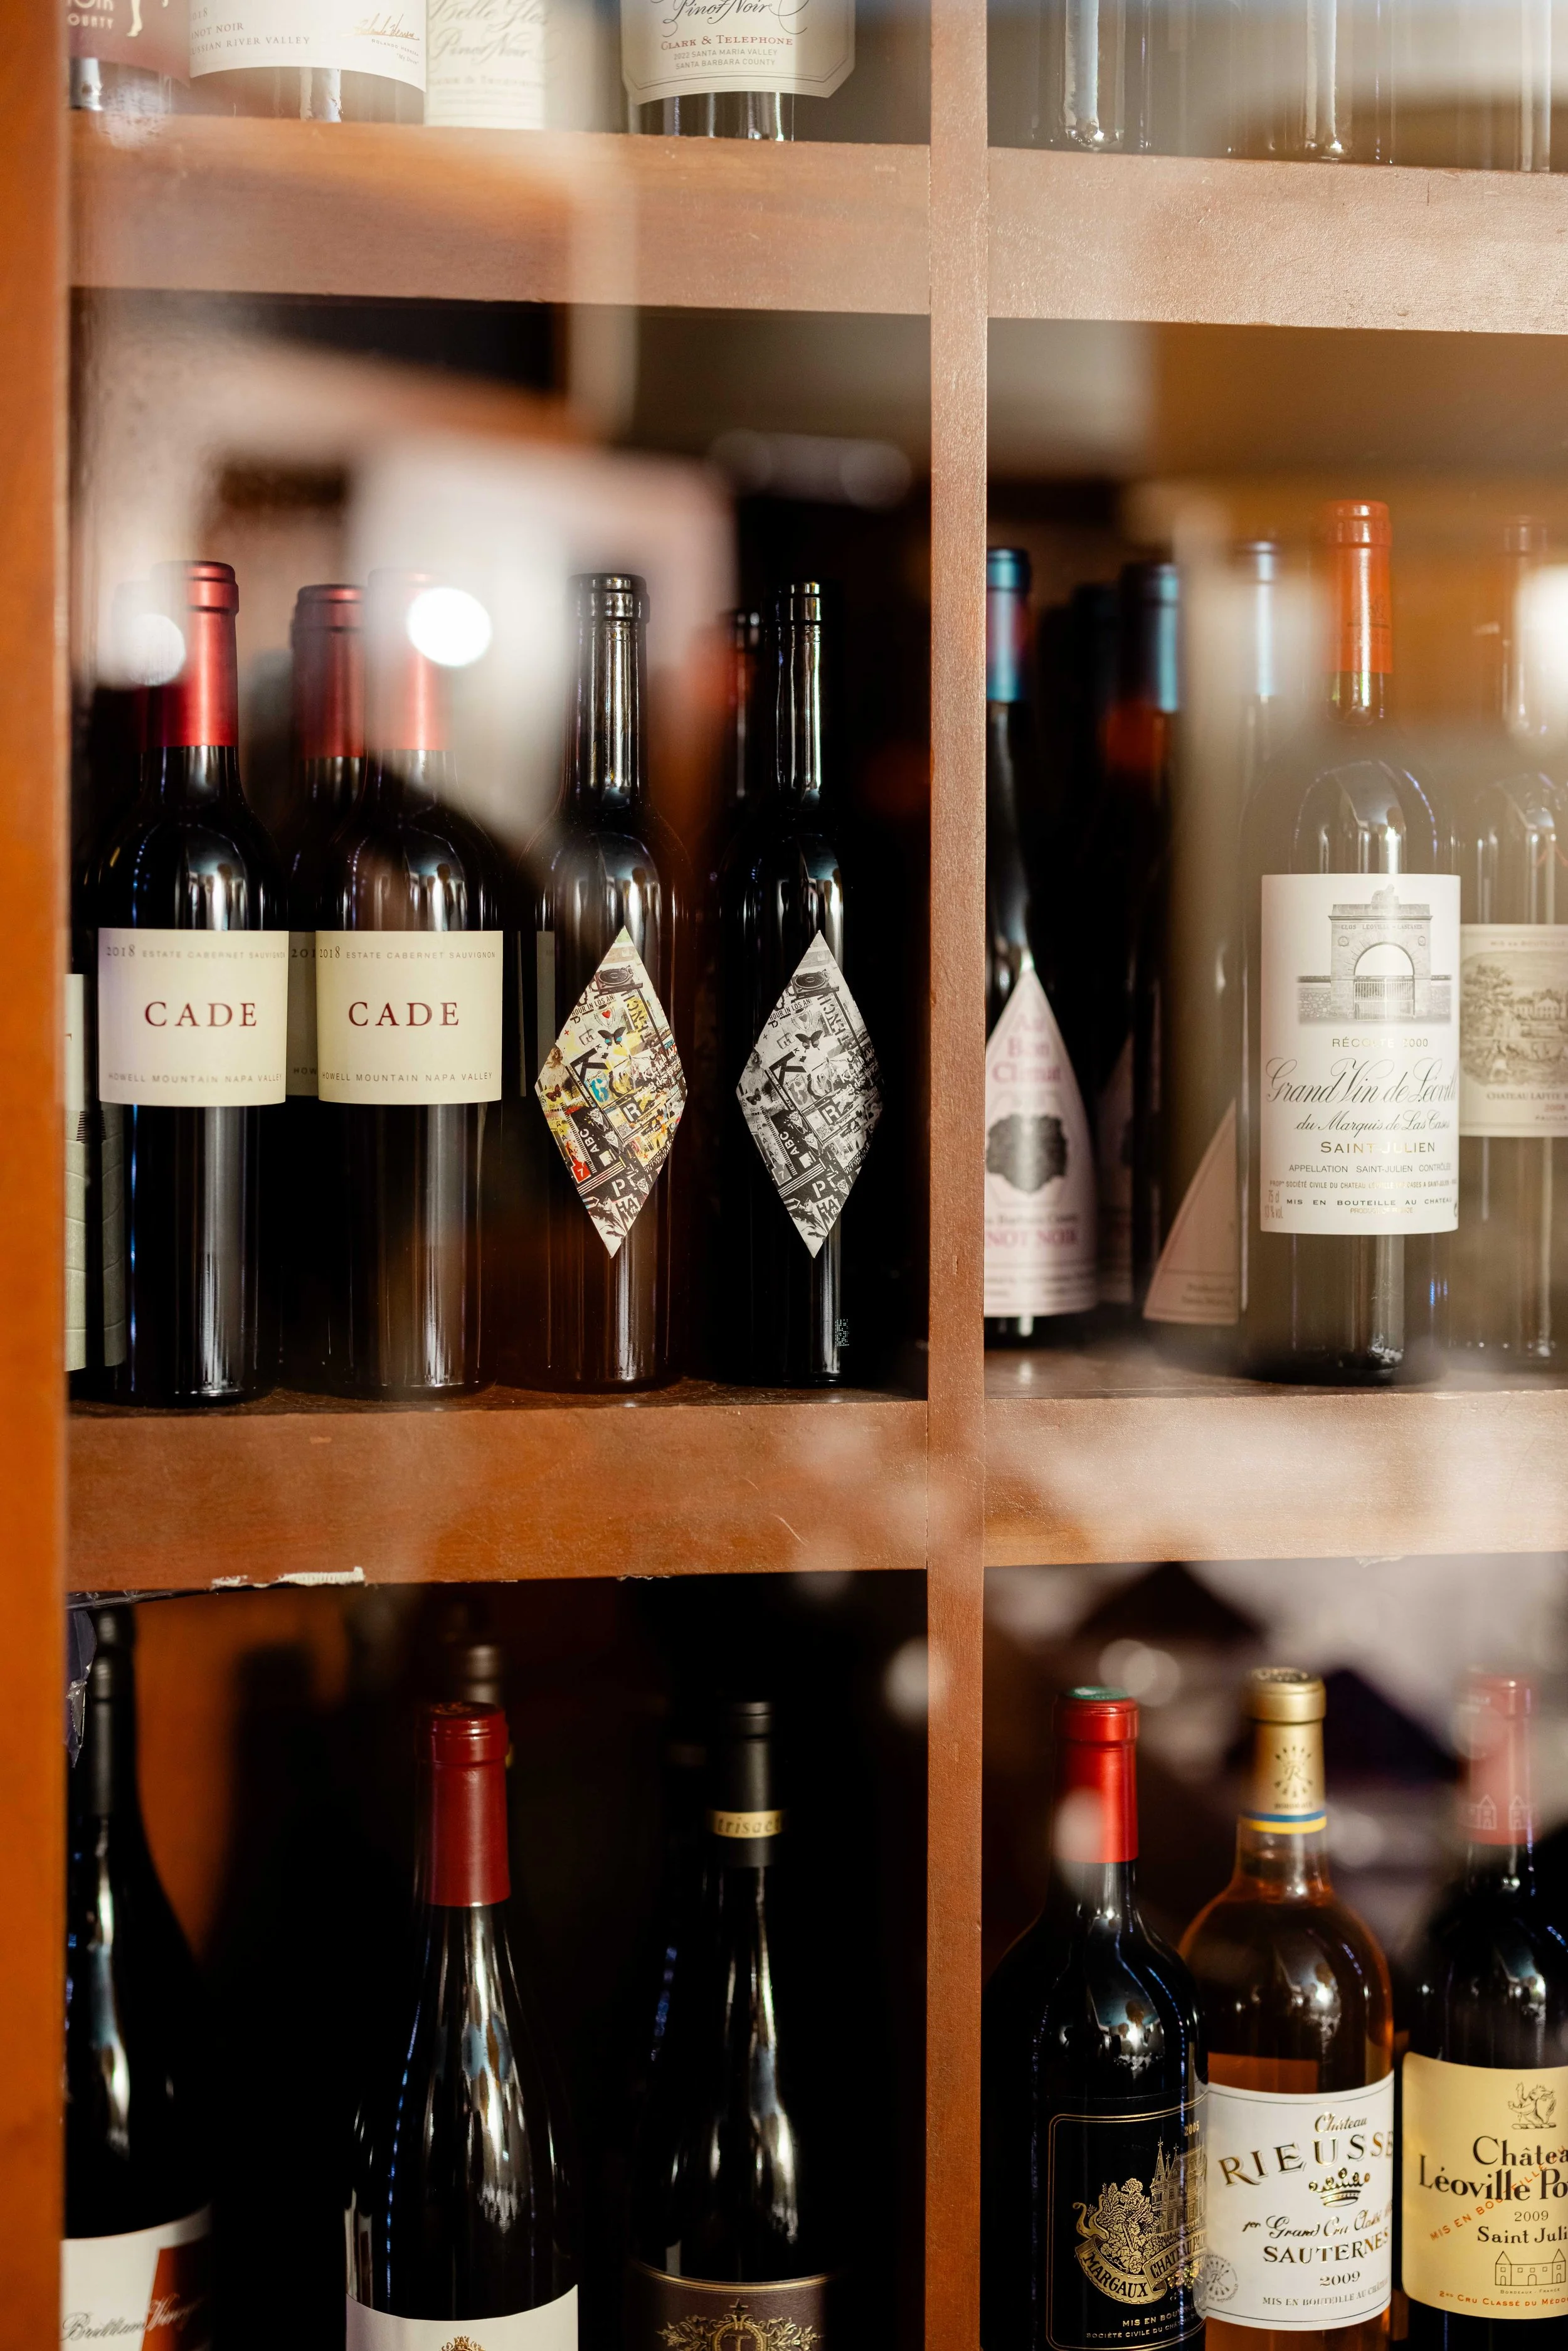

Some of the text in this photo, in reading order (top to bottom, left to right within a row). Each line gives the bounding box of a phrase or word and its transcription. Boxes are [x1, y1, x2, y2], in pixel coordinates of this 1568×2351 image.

[189, 7, 208, 21] 018
[216, 22, 244, 34] NOIR
[189, 36, 310, 56] USSIAN RIVER VALLEY
[371, 38, 399, 50] ROLANDO
[701, 35, 712, 45] &
[674, 48, 778, 61] 2022 SANTA MARIA VALLEY
[675, 58, 776, 70] SANTA BARBARA COUNTY
[106, 943, 136, 958] 2018
[142, 950, 182, 958] ESTATE
[187, 950, 245, 960] CABERNET
[319, 945, 341, 959] 2018
[386, 952, 445, 960] CABERNET
[448, 951, 496, 959] SAUVIGNON
[144, 1000, 258, 1027] CADE
[348, 1000, 460, 1027] CADE
[571, 1005, 587, 1017] HOUR
[586, 1002, 594, 1011] IN
[595, 998, 606, 1007] LOS
[769, 1011, 785, 1022] HOUR
[792, 1002, 803, 1012] LOS
[1403, 1038, 1429, 1048] 2000
[108, 1073, 146, 1083] HOWELL
[151, 1075, 218, 1084] MOUNTAIN
[225, 1075, 253, 1084] NAPA
[321, 1071, 493, 1083] HOWELL MOUNTAIN NAPA VALLEY
[1266, 1057, 1347, 1103] Grand
[1380, 1071, 1410, 1103] de
[1295, 1113, 1318, 1130] du
[1317, 1110, 1382, 1138] Marquis
[1383, 1114, 1403, 1130] de
[1402, 1109, 1426, 1130] Las
[579, 1128, 601, 1154] ABC
[780, 1131, 800, 1155] ABC
[1320, 1140, 1436, 1154] SAINT-JULIEN
[577, 1168, 585, 1177] 7
[778, 1170, 785, 1180] 7
[1289, 1164, 1348, 1173] APPELLATION
[612, 1179, 626, 1197] P
[812, 1180, 826, 1199] P
[1286, 1180, 1307, 1188] SOCIÉTÉ
[1184, 2122, 1200, 2137] 2005
[1315, 2111, 1368, 2133] Château
[1419, 2153, 1568, 2201] Léoville Po
[1429, 2225, 1451, 2241] MIS
[1453, 2213, 1473, 2228] EN
[1475, 2163, 1547, 2216] BOUEILLE
[1513, 2209, 1549, 2222] 2009
[1266, 2215, 1320, 2239] Grand
[1323, 2216, 1350, 2237] Cru
[1476, 2226, 1530, 2244] Saint
[1263, 2226, 1391, 2264] SAUTERNES
[1083, 2251, 1148, 2298] MARGAUX
[1319, 2270, 1361, 2286] 2009
[1262, 2296, 1286, 2306] MIS
[1286, 2298, 1300, 2306] EN
[1302, 2293, 1355, 2306] BOUTEILLE
[1356, 2290, 1366, 2300] AU
[1122, 2318, 1141, 2327] MIS
[1144, 2316, 1157, 2325] EN
[1086, 2330, 1123, 2338] SOCIÉTÉ
[1125, 2329, 1150, 2338] CIVILE
